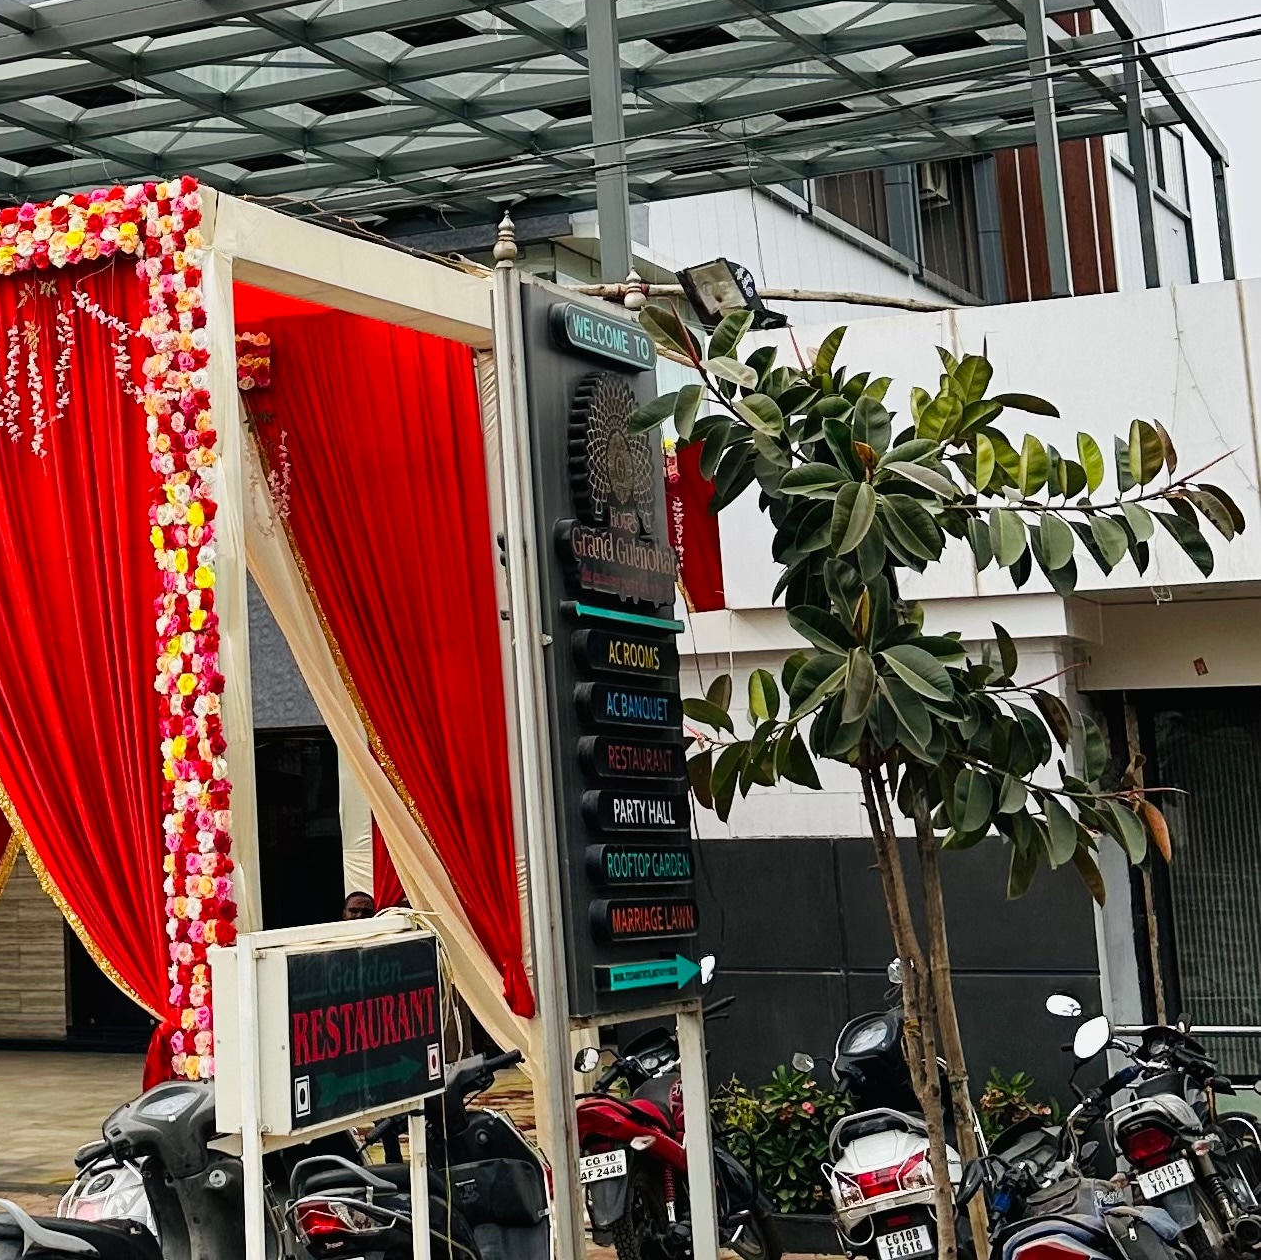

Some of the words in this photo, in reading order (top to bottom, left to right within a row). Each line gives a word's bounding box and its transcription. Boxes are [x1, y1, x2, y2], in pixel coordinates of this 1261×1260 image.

[572, 313, 630, 355] WELCOME
[633, 335, 650, 361] TO
[571, 526, 615, 563] Grand
[616, 537, 677, 576] Gulmohar
[608, 639, 623, 665] AC
[623, 641, 661, 671] ROOMS
[606, 691, 621, 717] AC
[621, 693, 669, 722] BANQUET
[607, 744, 673, 773] RESTAURANT
[613, 798, 646, 824] PARTY
[647, 799, 676, 825] HALL
[606, 852, 651, 878] ROOFTOP
[651, 852, 691, 877] GARDEN
[612, 906, 664, 933] MARRIAGE
[664, 905, 695, 930] LAWN
[328, 957, 402, 994] Garden
[292, 986, 436, 1067] RESTAURANT
[586, 1157, 600, 1167] CG
[605, 1153, 616, 1162] 10
[597, 1165, 623, 1177] 2448
[1147, 1162, 1183, 1184] CG10A
[885, 1228, 920, 1247] CG10B
